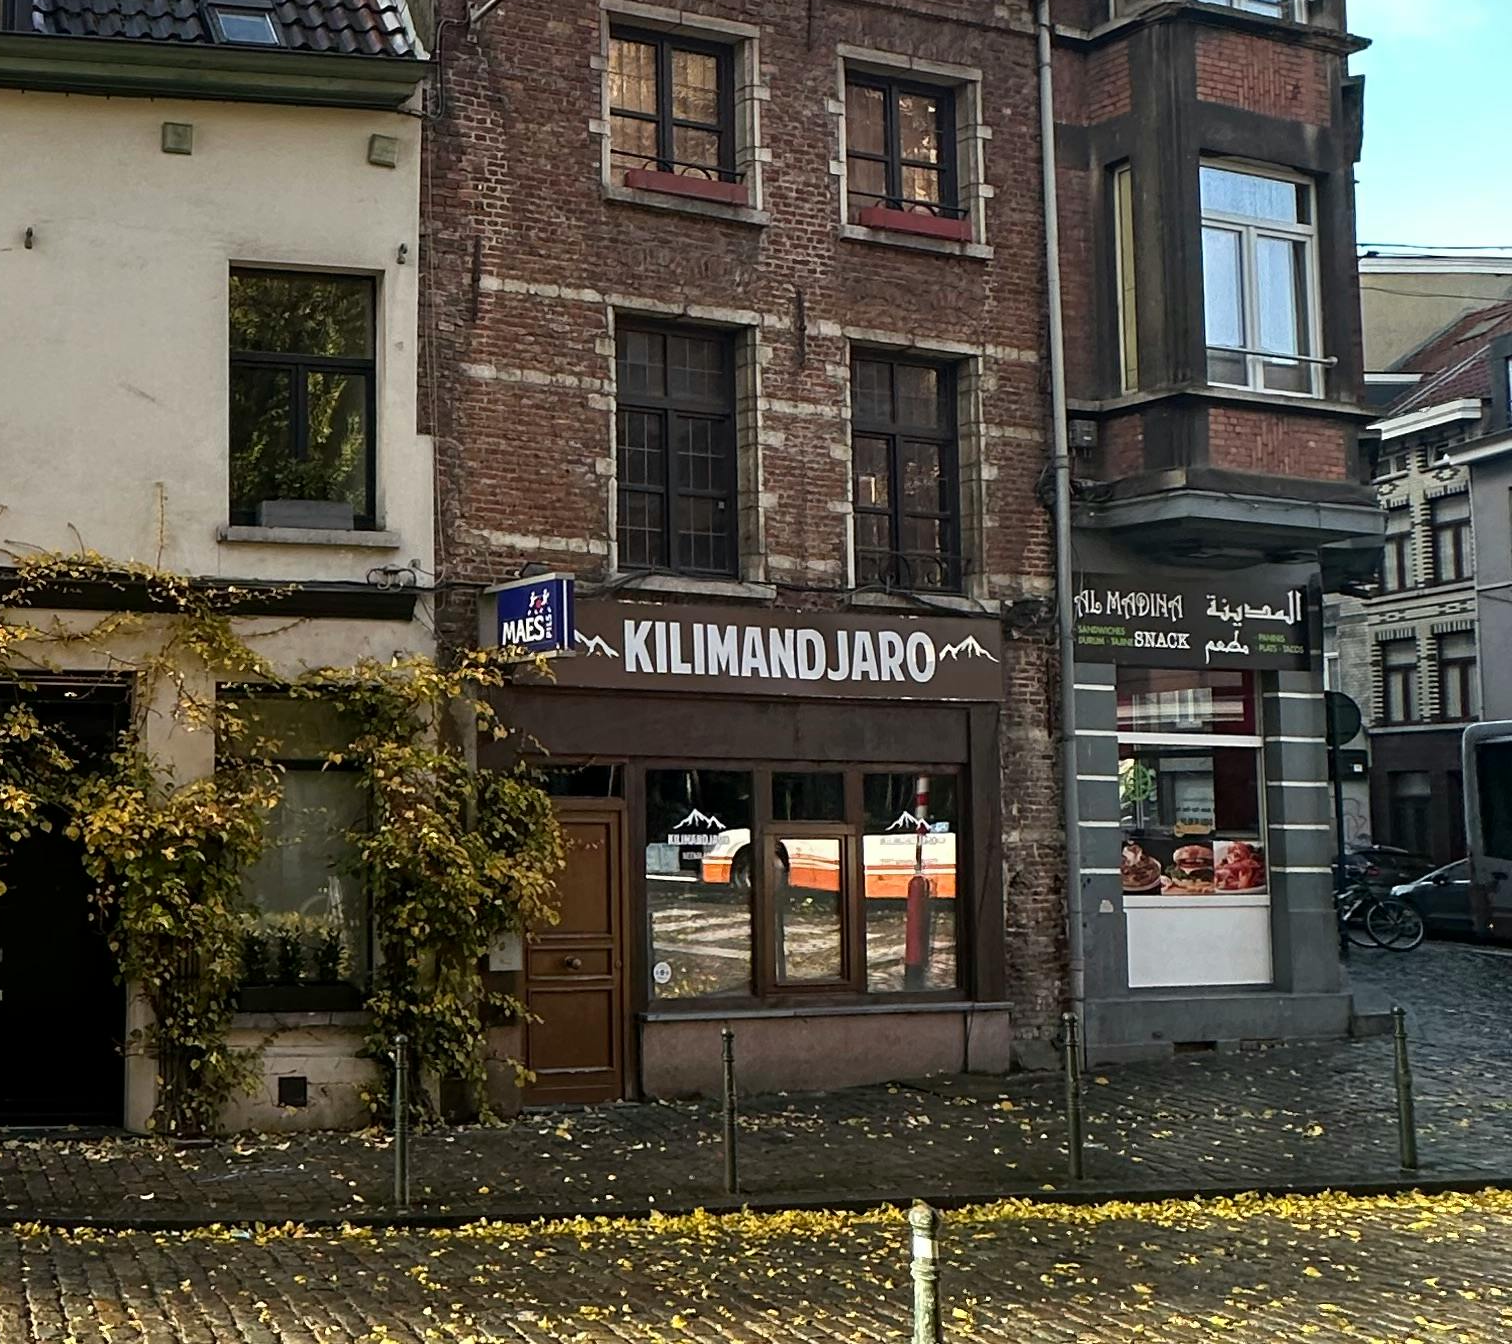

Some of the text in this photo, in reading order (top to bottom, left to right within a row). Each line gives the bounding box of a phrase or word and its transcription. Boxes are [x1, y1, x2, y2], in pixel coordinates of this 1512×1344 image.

[1074, 589, 1184, 622] AL MADINA
[1206, 589, 1302, 627] المدينة
[502, 615, 545, 646] MAES
[545, 613, 553, 639] PILS
[1134, 630, 1191, 649] SNACK
[624, 620, 936, 683] KILIMANDJARO
[1205, 629, 1250, 664] مطعم
